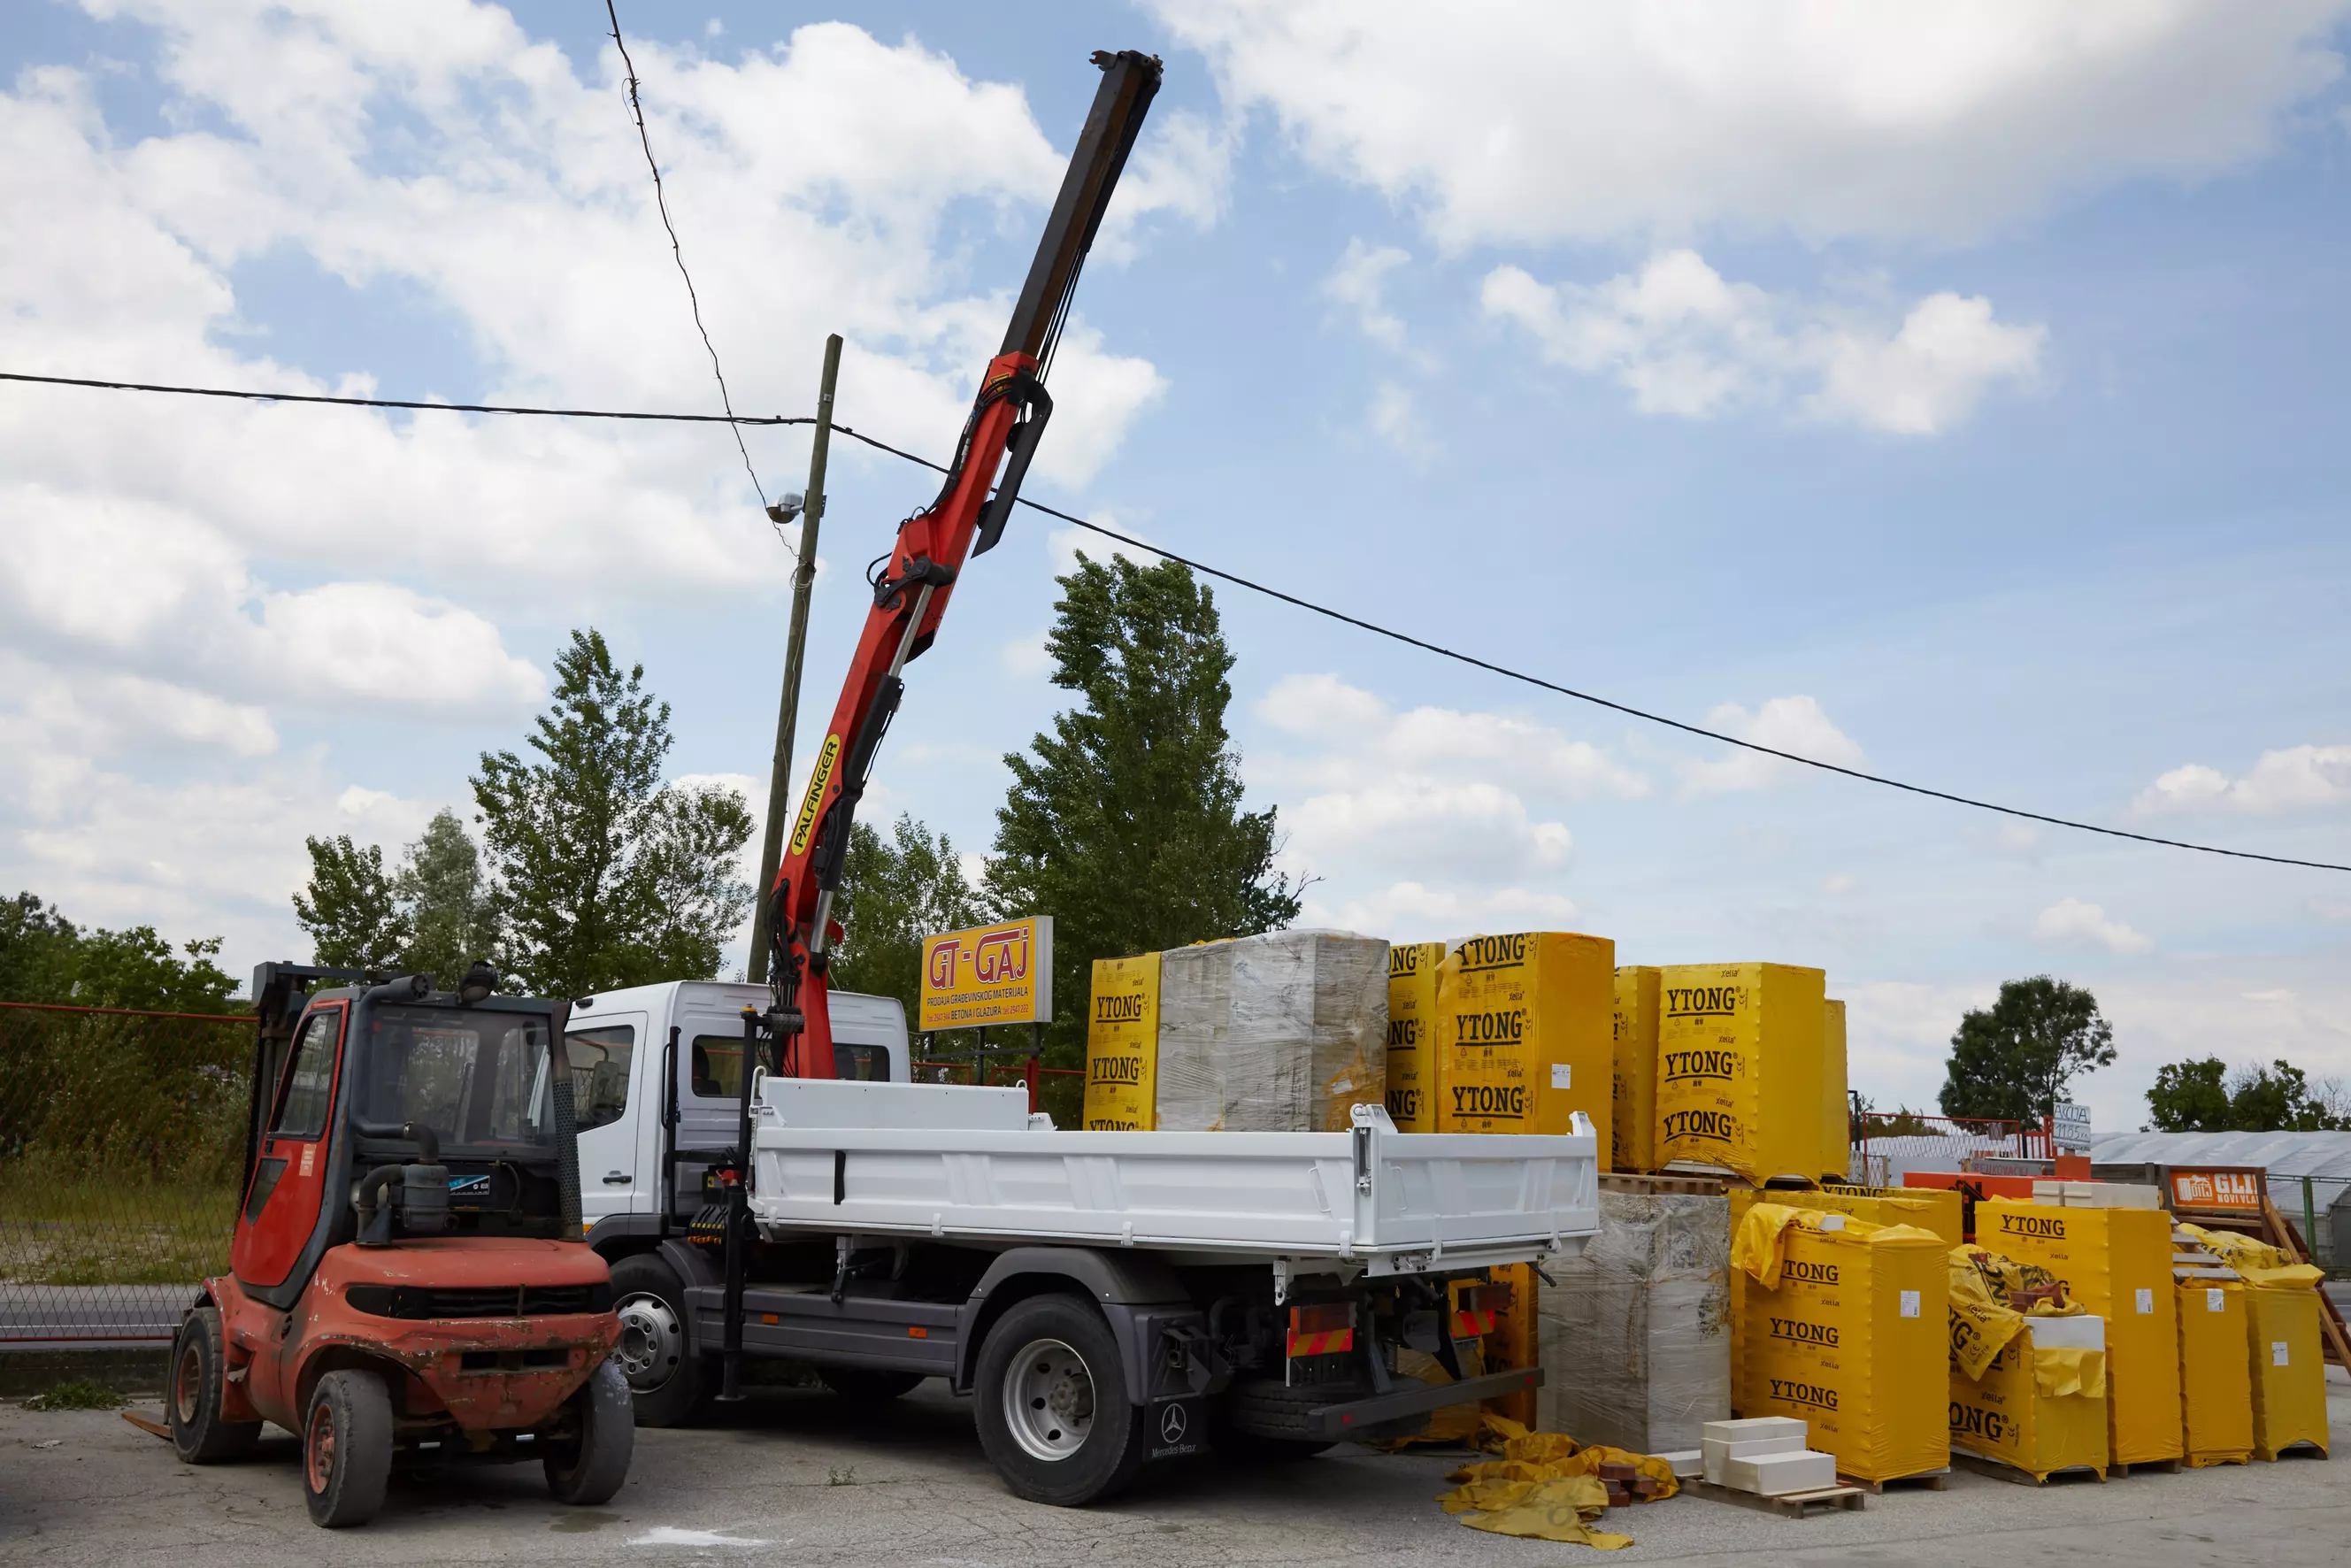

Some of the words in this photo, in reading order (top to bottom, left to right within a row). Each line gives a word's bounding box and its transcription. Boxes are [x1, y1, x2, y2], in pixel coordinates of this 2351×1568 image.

[794, 741, 838, 849] PALFINGER
[927, 995, 950, 1006] PRODAJA
[993, 986, 1028, 999] MATERIJALA
[1667, 987, 1735, 1011] YTONG
[951, 1009, 972, 1019] BETONA
[976, 1005, 1001, 1018] GLAZURA
[1456, 1010, 1522, 1040] YTONG
[1665, 1050, 1733, 1076] YTONG
[1452, 1086, 1523, 1113] YTONG
[1663, 1110, 1732, 1137] YTONG
[2055, 1104, 2087, 1123] AKCIJA
[2217, 1194, 2239, 1203] NOVI
[2001, 1214, 2065, 1236] YTONG
[1785, 1259, 1839, 1281] TONG
[1770, 1318, 1839, 1344] YTONG
[1770, 1380, 1838, 1407] YTONG
[1948, 1402, 2003, 1438] ONG
